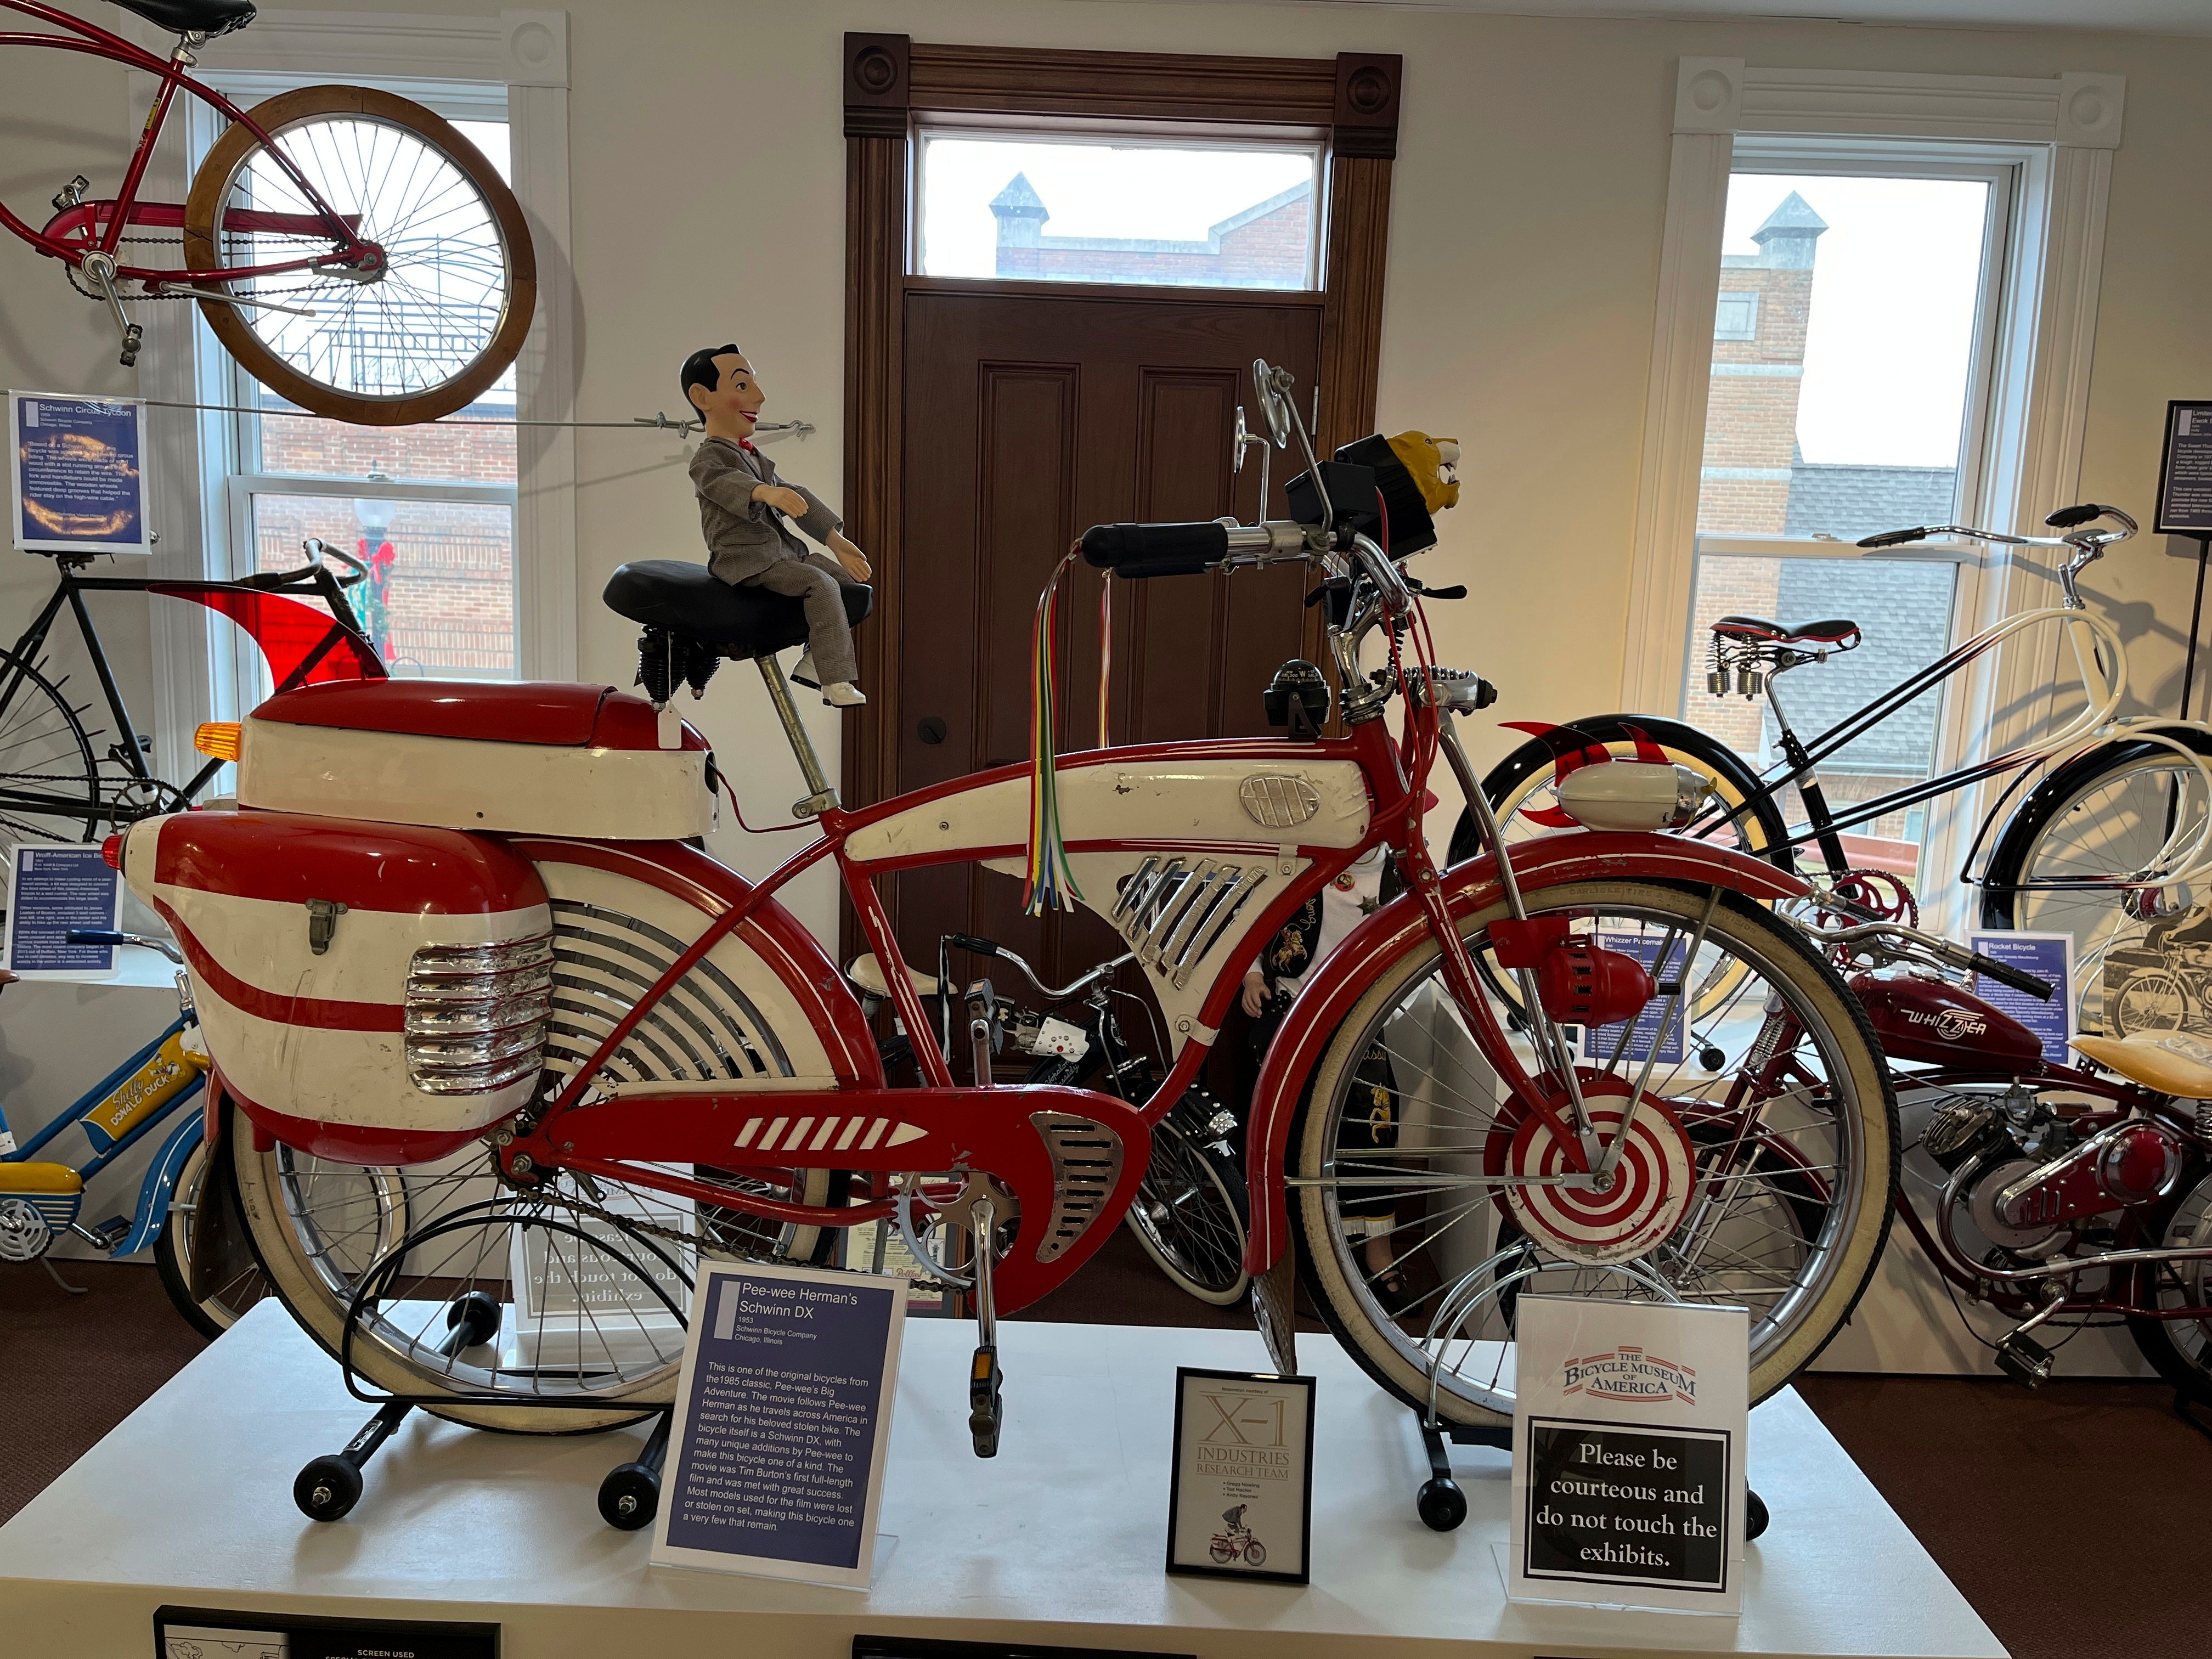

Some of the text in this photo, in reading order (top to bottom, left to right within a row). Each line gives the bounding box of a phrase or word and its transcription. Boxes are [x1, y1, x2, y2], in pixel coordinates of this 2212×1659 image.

[40, 404, 132, 417] Schwinn Circus Tycoon
[1626, 888, 1654, 896] TIRE
[1669, 895, 1705, 906] RUBBE
[1605, 936, 1663, 946] Whizzer Pcemak
[2013, 943, 2036, 952] Bicycle
[1901, 1010, 1987, 1037] WHIZZER
[1045, 1060, 1069, 1084] Hopalon
[110, 1074, 170, 1126] DONALD DUCK
[742, 1282, 857, 1305] Pee-wee Herman's
[738, 1316, 754, 1324] 1953
[739, 1300, 814, 1319] Schwinn DX
[734, 1333, 783, 1345] Chicago, Illinois
[735, 1324, 817, 1341] Schwinn Bicycle Company
[1618, 1353, 1641, 1362] THE
[708, 1361, 868, 1387] This is one of the original bicycles from
[1564, 1362, 1696, 1397] BICYCLE MUSEUM
[1591, 1378, 1669, 1394] AMERICA
[703, 1386, 866, 1412] Adventure. The movie follows Pee-wee
[741, 1378, 772, 1390] classic,
[774, 1380, 819, 1394] Pee-wee's
[820, 1385, 835, 1398] Big
[701, 1397, 868, 1425] Herman as he travels across America in
[1198, 1395, 1285, 1446] X-1
[697, 1422, 727, 1435] bicycle
[728, 1426, 750, 1437] itself
[750, 1428, 758, 1438] is
[767, 1430, 804, 1443] Schwinn
[805, 1435, 821, 1446] DX,
[824, 1437, 842, 1447] with
[699, 1412, 861, 1437] search for his beloved stolen bike. The
[693, 1449, 717, 1459] make
[719, 1451, 735, 1461] this
[736, 1452, 766, 1465] bicycle
[767, 1458, 784, 1466] one
[785, 1458, 796, 1468] of
[804, 1460, 825, 1471] kind.
[827, 1462, 844, 1474] The
[695, 1437, 853, 1462] many unique additions by Pee-wee to
[1197, 1447, 1289, 1465] INDUSTRIES
[1579, 1443, 1677, 1470] Please be
[691, 1462, 853, 1488] movie was Tim Burton's first full-length
[1197, 1465, 1289, 1479] RESEARCH TEAM
[689, 1472, 842, 1499] film and was met with great success.
[1550, 1480, 1704, 1504] courteous and
[686, 1485, 853, 1514] Most models used for the film were lost
[684, 1500, 855, 1527] or stolen on set, making this bicycle one
[690, 1514, 710, 1525] very
[710, 1514, 727, 1525] few
[728, 1516, 745, 1528] that
[746, 1520, 778, 1531] remain.
[1536, 1504, 1717, 1538] do not touch the
[1579, 1541, 1670, 1566] exhibits.
